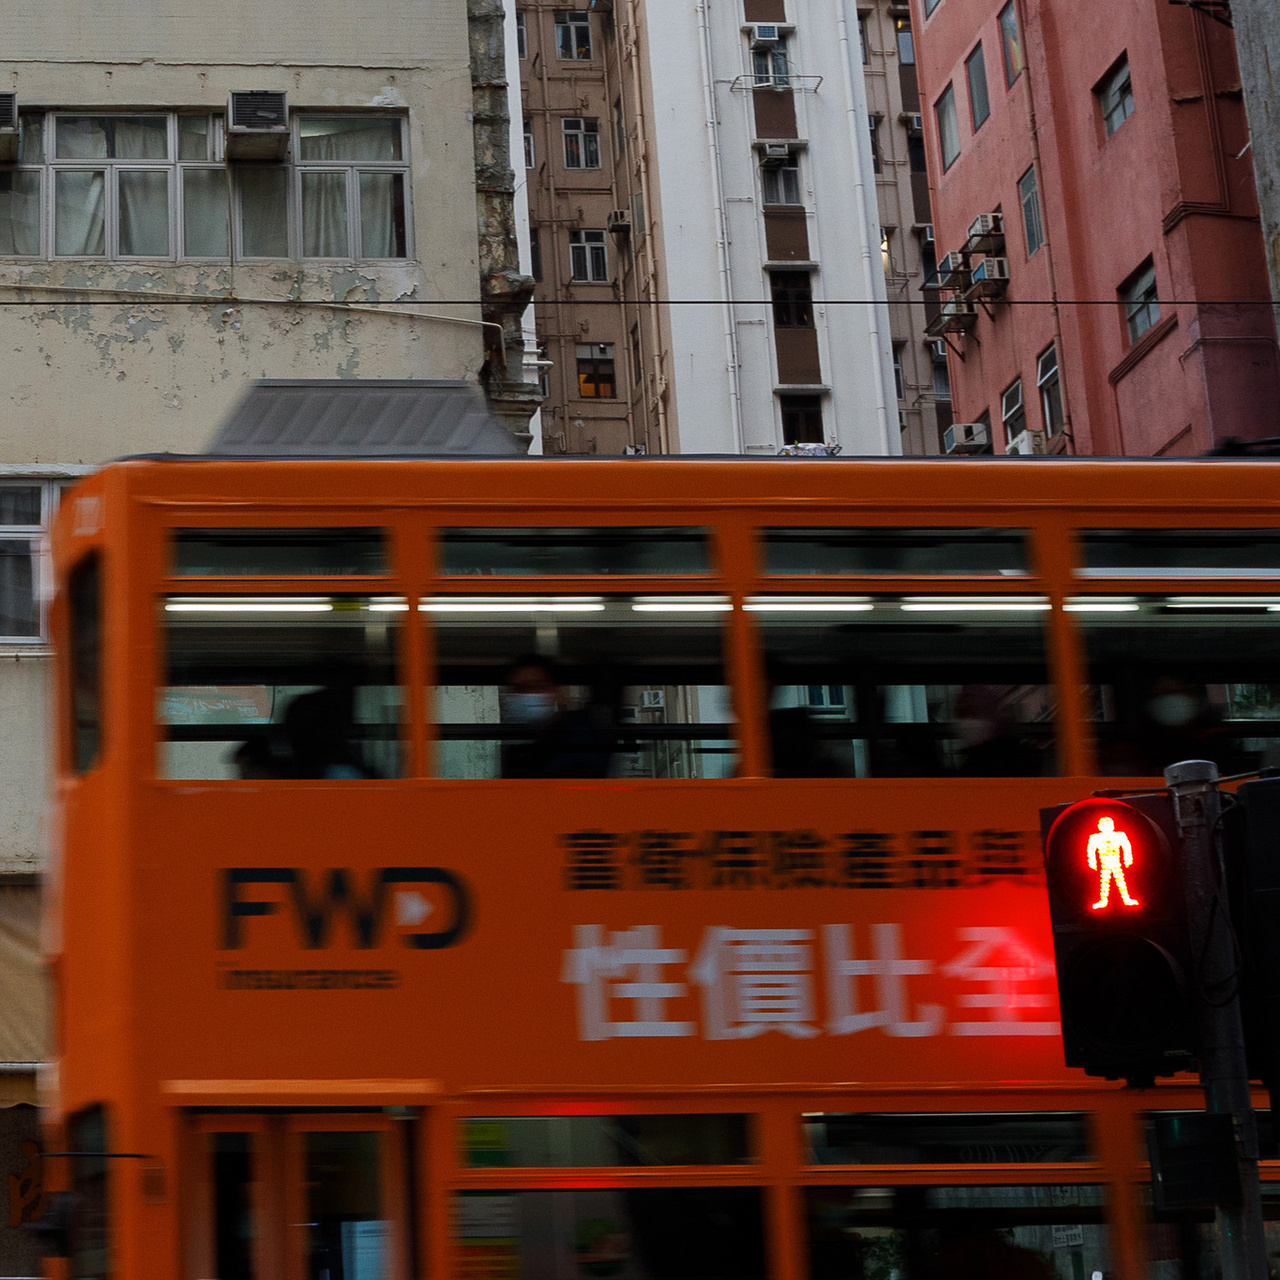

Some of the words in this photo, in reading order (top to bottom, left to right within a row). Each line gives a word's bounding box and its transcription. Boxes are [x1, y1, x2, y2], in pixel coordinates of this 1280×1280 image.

[217, 867, 475, 950] FWD
[561, 923, 1061, 1041] 性價比全
